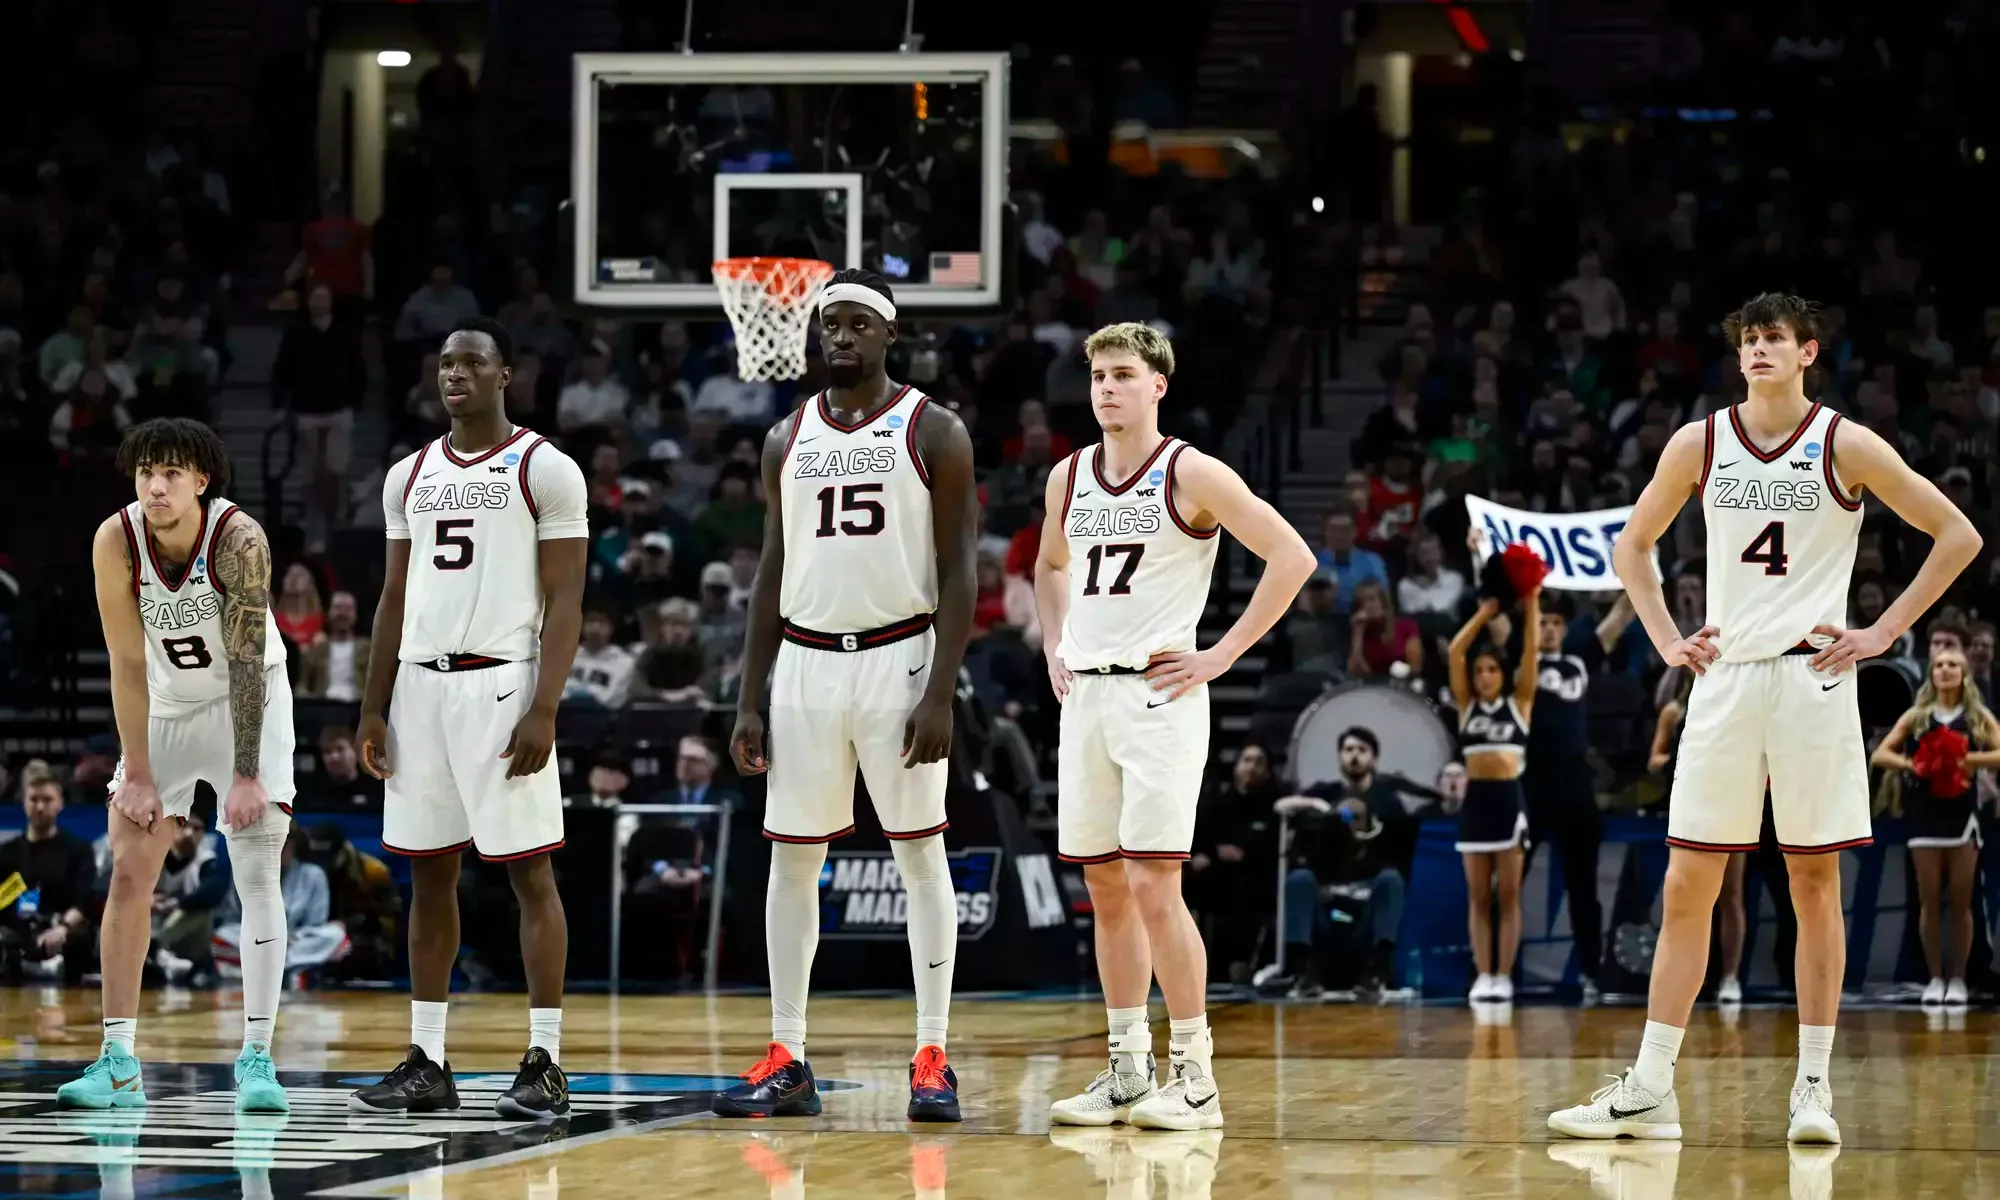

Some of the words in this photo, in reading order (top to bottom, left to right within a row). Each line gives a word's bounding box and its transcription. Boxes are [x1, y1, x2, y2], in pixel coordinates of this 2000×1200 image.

[795, 446, 896, 479] ZAGS
[413, 482, 510, 513] ZAGS
[1136, 488, 1156, 497] WCC
[1714, 477, 1820, 511] ZAGS
[816, 483, 885, 538] 15
[1069, 504, 1160, 537] ZAGS
[433, 518, 474, 570] 5
[1741, 521, 1788, 576] 4
[1083, 543, 1145, 596] 17
[140, 591, 220, 630] ZAGS
[161, 635, 213, 670] 8
[842, 634, 858, 651] G
[833, 859, 906, 891] MAR
[845, 892, 991, 924] MADSS
